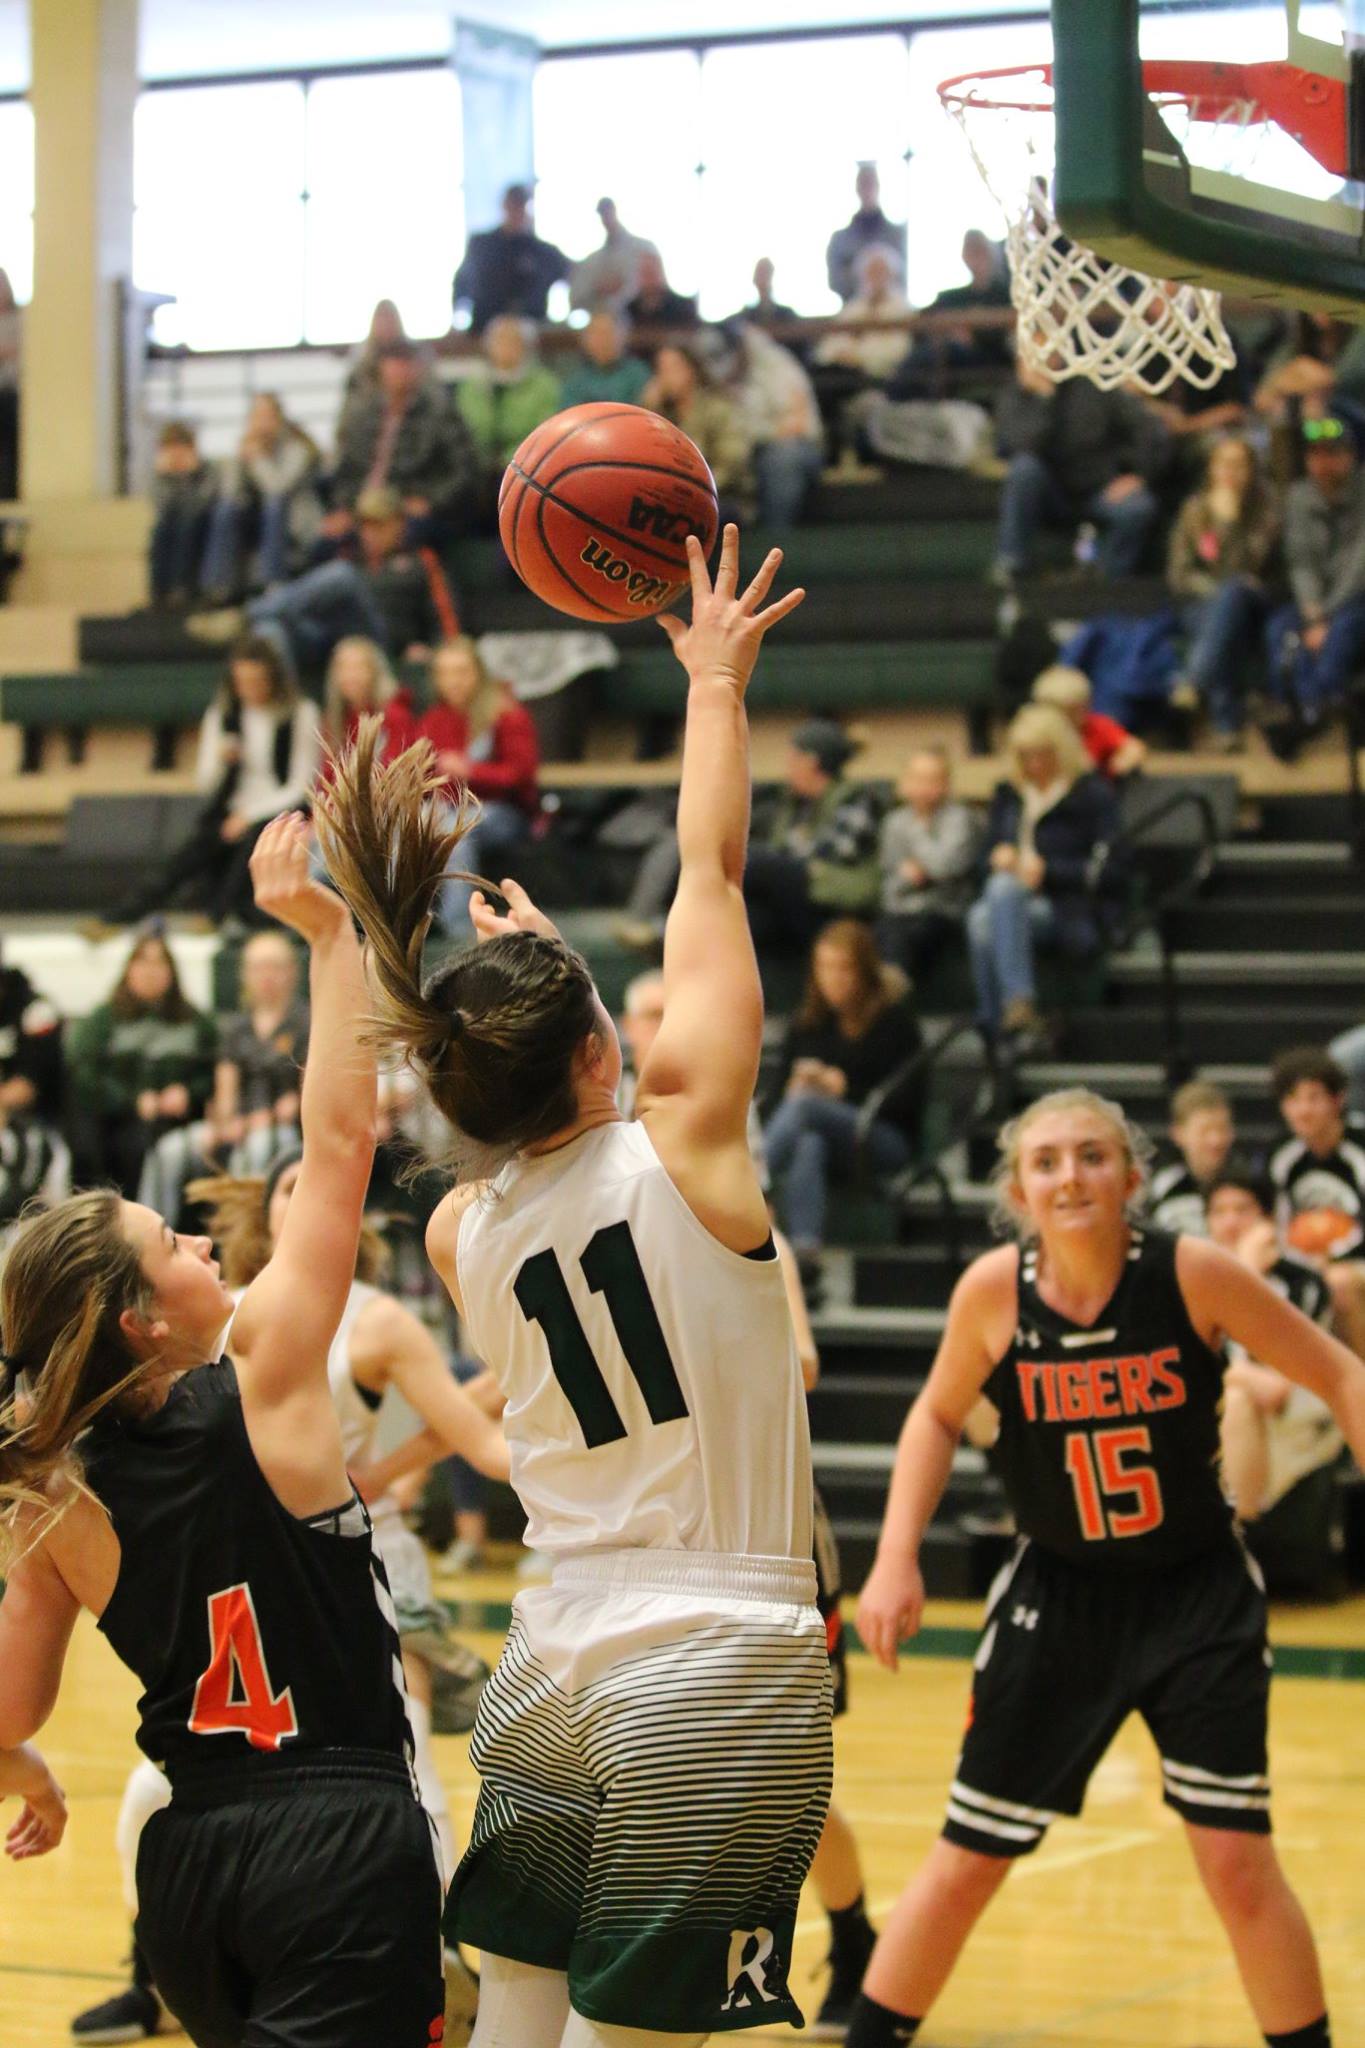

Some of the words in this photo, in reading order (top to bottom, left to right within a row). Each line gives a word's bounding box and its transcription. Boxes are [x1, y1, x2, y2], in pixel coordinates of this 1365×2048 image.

[512, 1218, 691, 1450] 11
[1015, 1345, 1187, 1422] TIGERS
[1064, 1425, 1165, 1541] 15
[186, 1581, 299, 1752] 4
[720, 1925, 780, 2011] R
